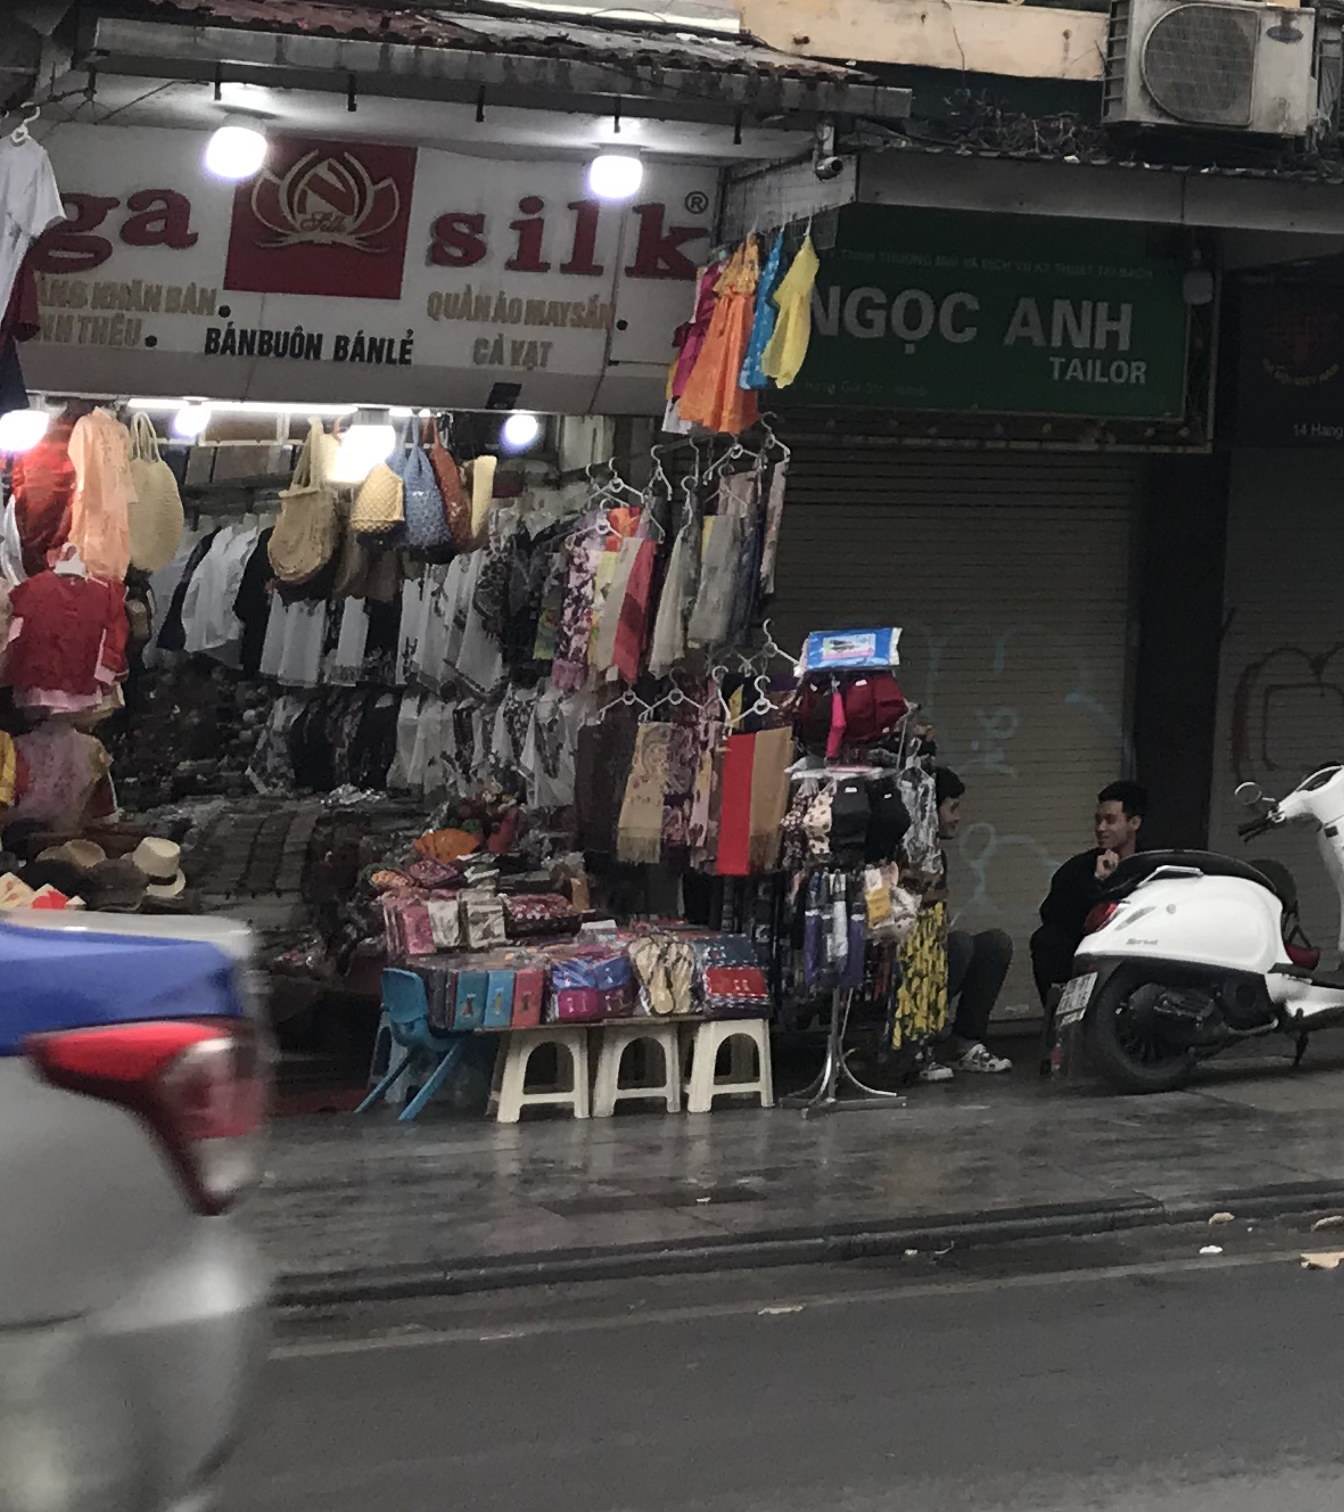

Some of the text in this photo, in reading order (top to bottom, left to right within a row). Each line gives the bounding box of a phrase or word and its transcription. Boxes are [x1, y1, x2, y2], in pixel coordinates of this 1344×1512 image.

[30, 188, 708, 281] ga silk
[811, 285, 1133, 354] NGỌC ANH
[1049, 356, 1147, 385] TAILOR
